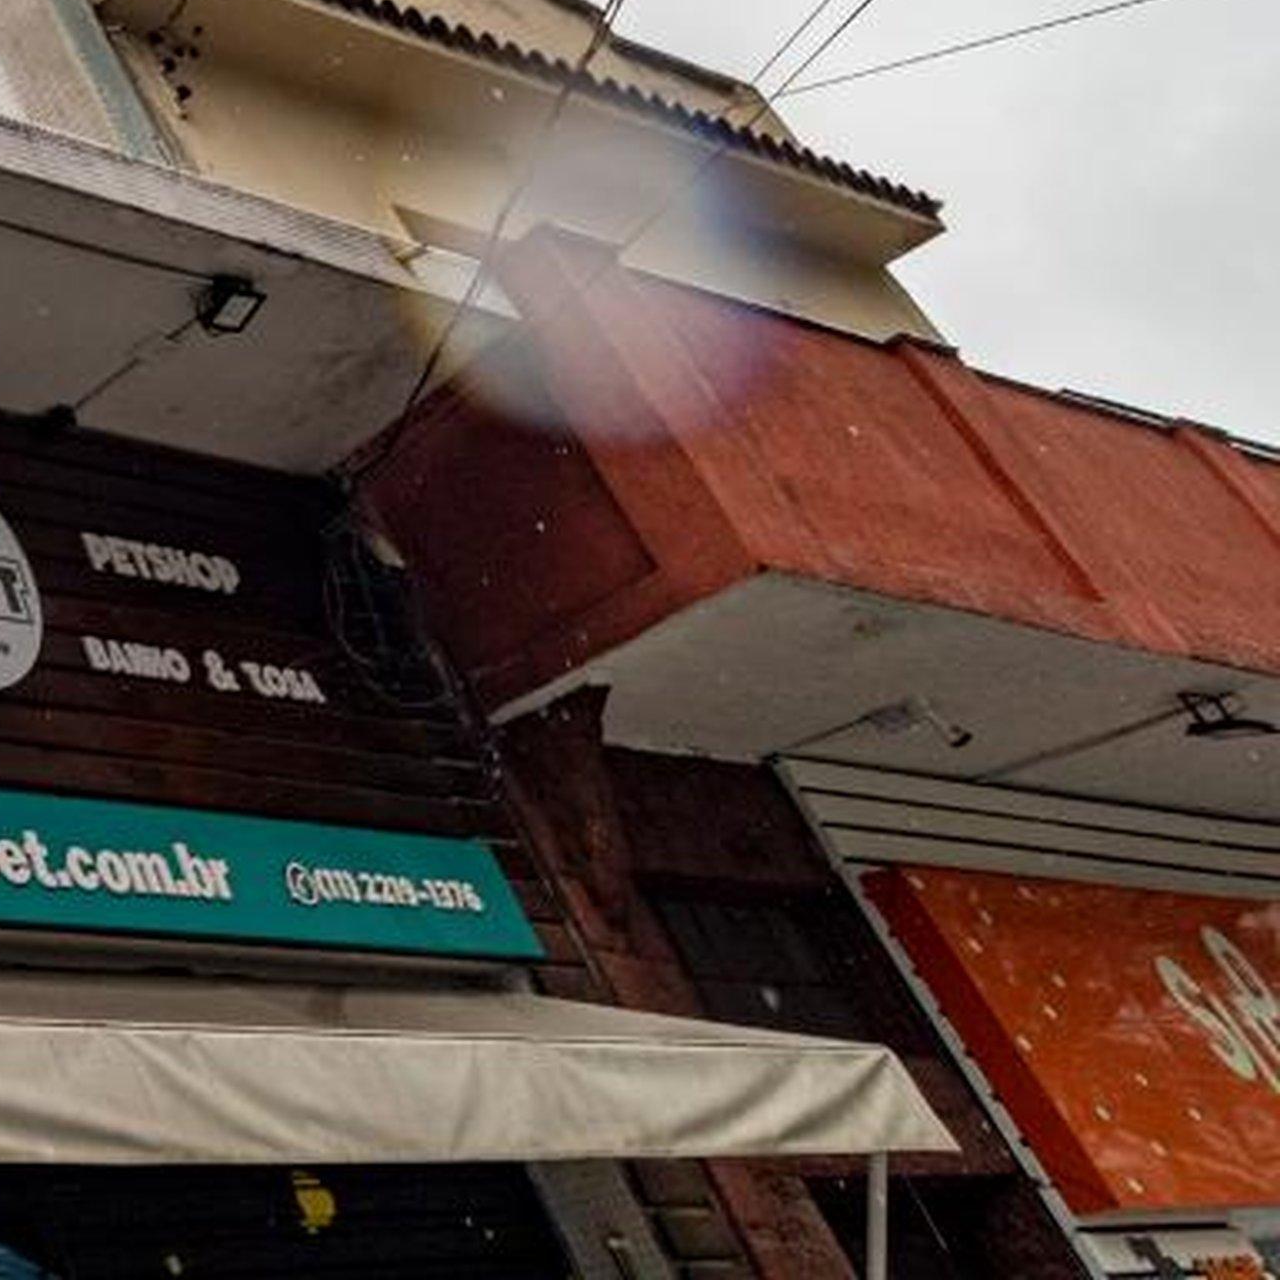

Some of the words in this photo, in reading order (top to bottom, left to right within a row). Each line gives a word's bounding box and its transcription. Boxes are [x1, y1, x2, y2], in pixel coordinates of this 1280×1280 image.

[80, 532, 240, 595] PETSHOP
[81, 635, 190, 683] BANHO
[202, 649, 241, 691] &
[240, 661, 327, 704] TOSA
[313, 869, 361, 903] (11)
